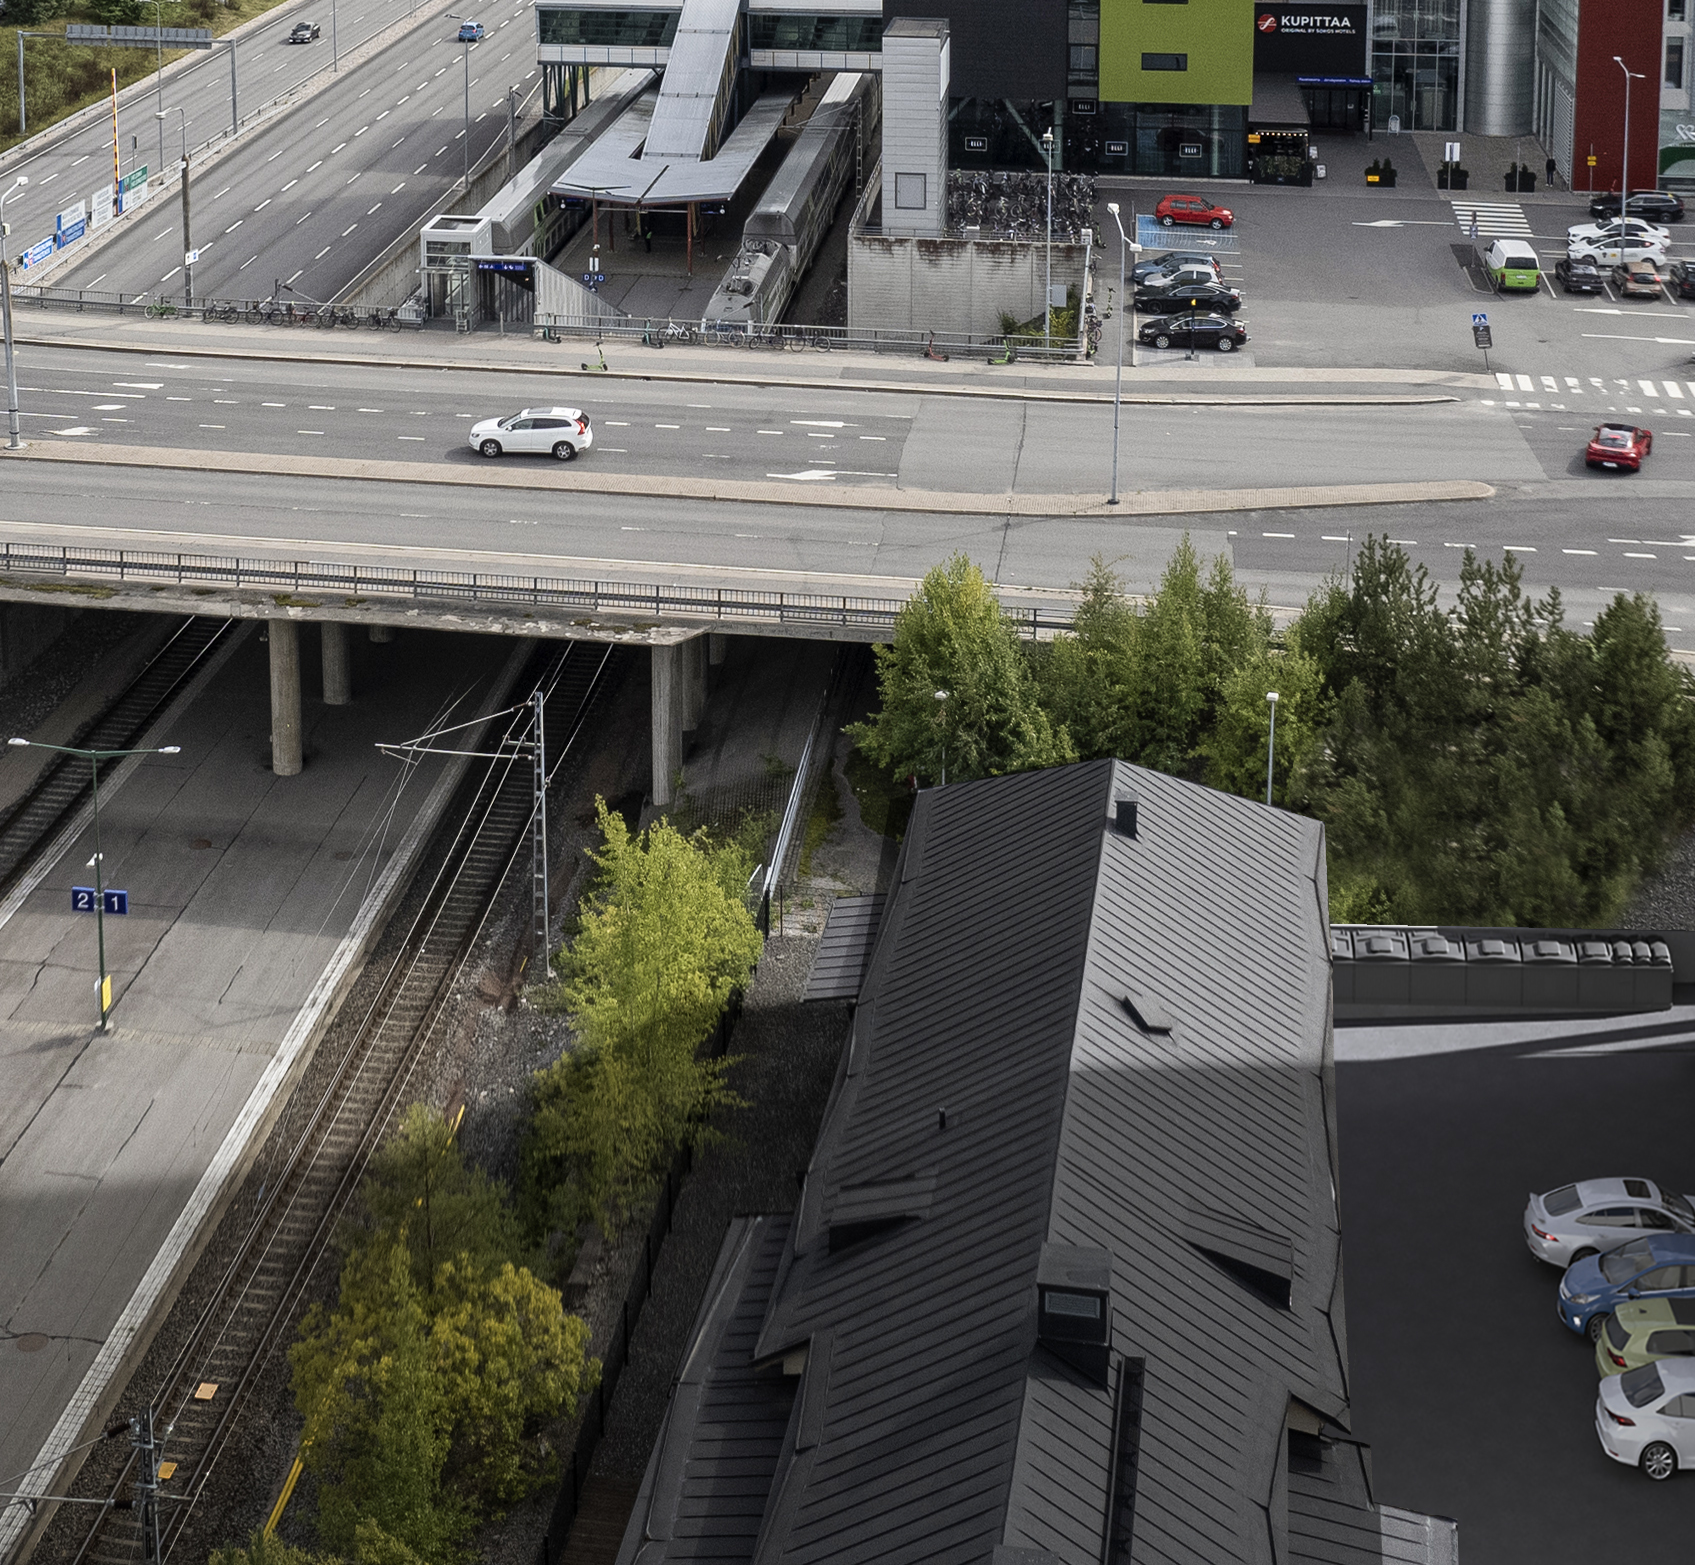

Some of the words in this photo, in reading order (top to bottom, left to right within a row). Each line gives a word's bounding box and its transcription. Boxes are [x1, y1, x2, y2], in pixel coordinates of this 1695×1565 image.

[1281, 16, 1351, 27] KUPITTAA
[77, 892, 89, 908] 2
[111, 896, 118, 911] 1
